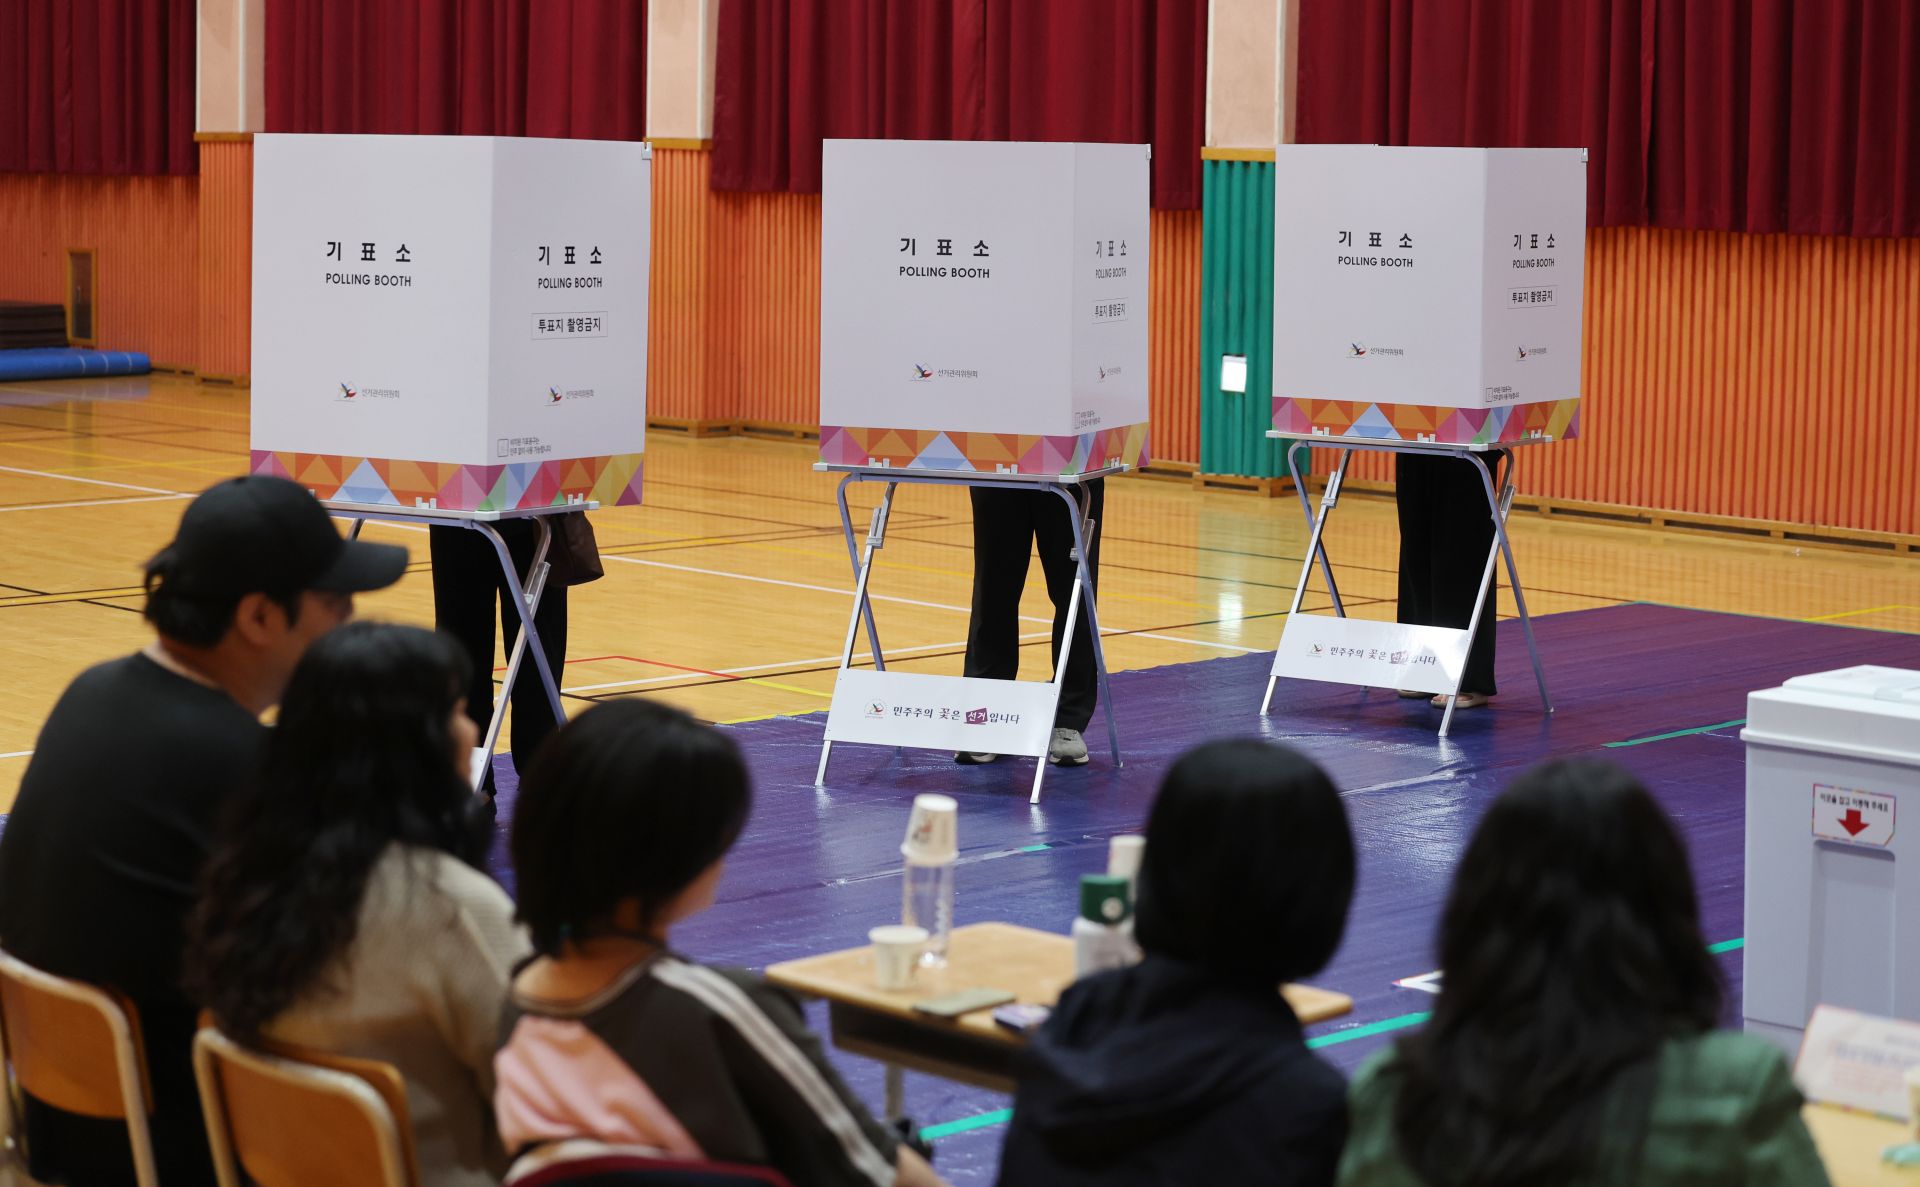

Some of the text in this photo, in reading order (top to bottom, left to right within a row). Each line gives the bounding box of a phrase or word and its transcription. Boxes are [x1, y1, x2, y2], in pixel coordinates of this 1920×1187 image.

[1338, 256, 1413, 268] POLLING BOOTH
[1512, 258, 1555, 269] POLLING BOOTH
[899, 266, 990, 279] POLLING BOOTH
[1095, 267, 1127, 279] POLLING BOOTH
[326, 273, 411, 287] POLLING BOOTH
[538, 277, 602, 289] POLLING BOOTH
[1512, 291, 1529, 304] 투표지
[538, 317, 601, 333] 투표지 촬영금지
[937, 369, 978, 378] 선거관리위원회
[1330, 646, 1364, 658] 민주주의
[1368, 648, 1387, 661] 꽃은
[893, 705, 1020, 725] 민주주의 꽃은 선거입니다
